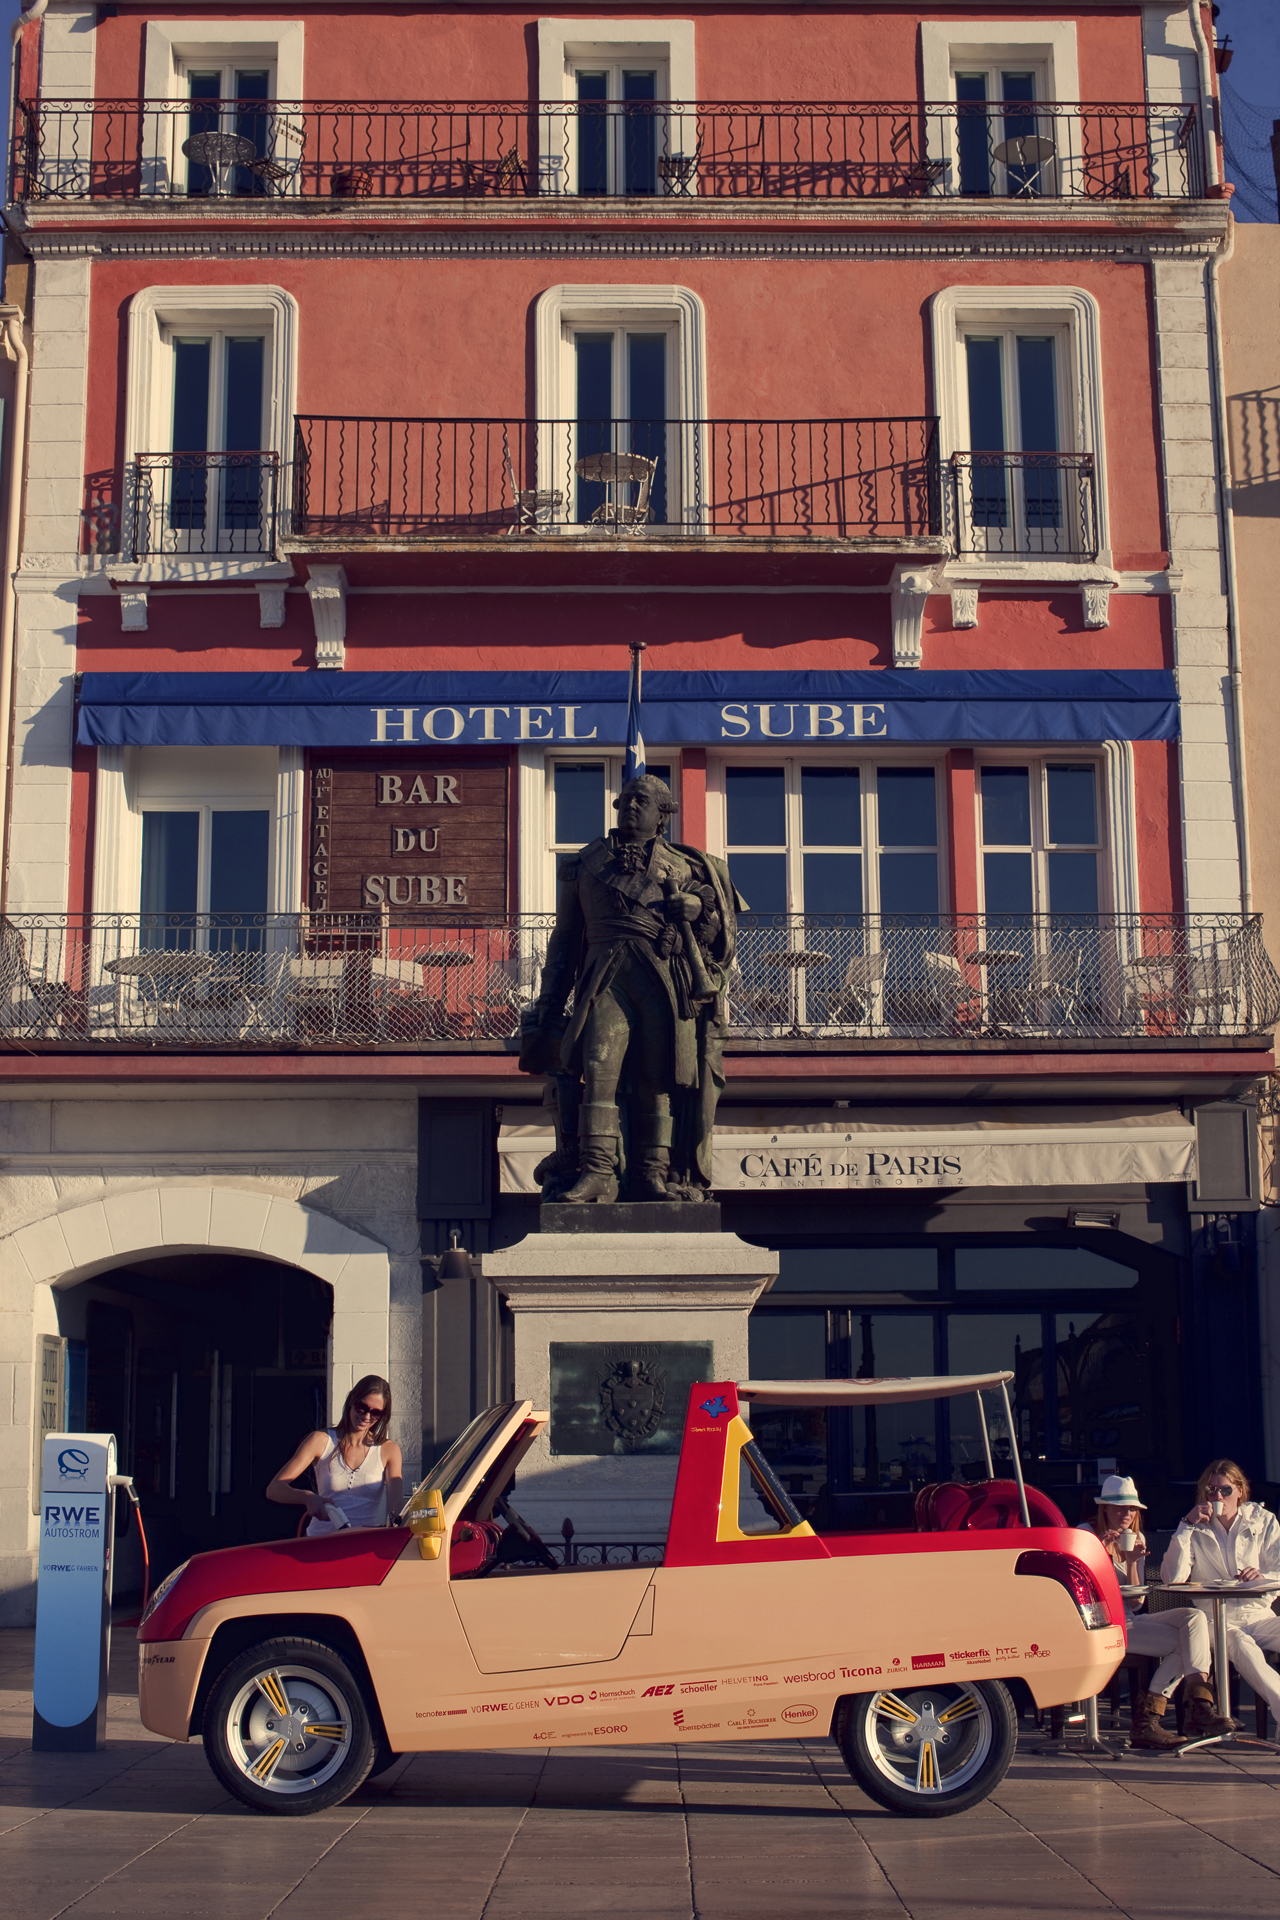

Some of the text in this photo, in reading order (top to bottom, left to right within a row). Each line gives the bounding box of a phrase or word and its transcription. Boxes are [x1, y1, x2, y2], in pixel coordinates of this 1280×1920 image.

[370, 703, 888, 742] HOTEL SUBE
[316, 768, 331, 779] AU
[379, 775, 461, 804] BAR
[394, 828, 441, 853] DU
[313, 805, 330, 894] ETAGE
[364, 875, 469, 906] SUBE
[739, 1152, 962, 1178] CAFÉ DE PARIS
[603, 1345, 616, 1357] DE
[618, 1344, 661, 1357] SUFFREN
[45, 1506, 100, 1522] RWE
[44, 1528, 100, 1538] AUTOSTROM
[950, 1648, 990, 1659] stickerfix
[783, 1670, 836, 1684] weisbrod
[840, 1666, 882, 1678] Ticona
[722, 1675, 768, 1685] HELVETING
[599, 1689, 636, 1698] Hornschuch
[640, 1684, 676, 1698] AEZ
[680, 1684, 718, 1694] schoeller
[543, 1694, 585, 1706] VDO
[471, 1700, 540, 1713] VORWEG GEHEN
[416, 1710, 447, 1719] tecnotex
[784, 1708, 814, 1719] Henkel
[594, 1725, 628, 1735] ESORO
